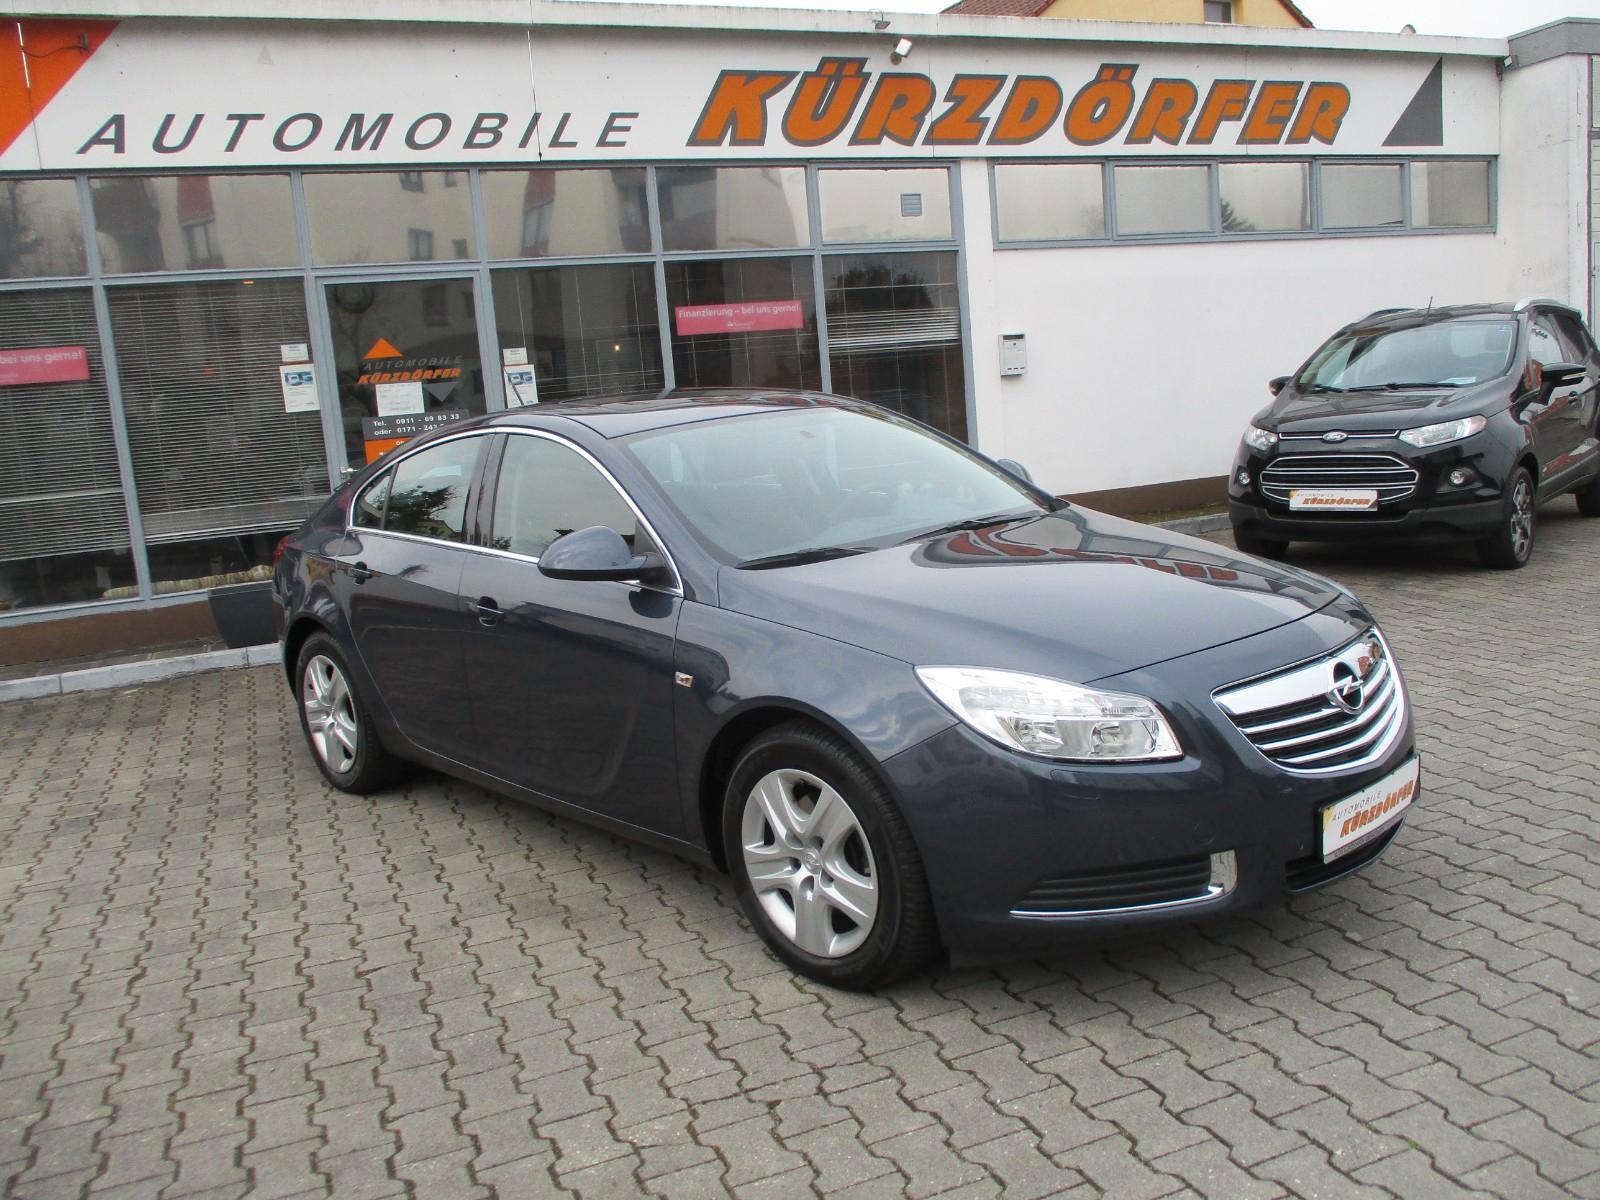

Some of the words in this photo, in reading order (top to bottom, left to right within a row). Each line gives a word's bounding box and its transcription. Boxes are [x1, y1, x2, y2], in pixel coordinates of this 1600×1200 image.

[75, 112, 639, 154] AUTOMOBILE
[685, 56, 1351, 147] KÜRZDÖRFER
[679, 307, 733, 318] Finanzierung
[741, 305, 754, 314] bei
[757, 305, 771, 313] uns
[772, 303, 800, 314] gerne!
[20, 354, 41, 363] uns
[44, 350, 82, 364] gerne!
[364, 355, 463, 370] AUTOMOBILE
[357, 367, 462, 385] KÜRZDÖRFER
[396, 417, 414, 425] 0911
[1332, 790, 1382, 821] AUTOMOBILE
[1340, 780, 1414, 838] KÜRZDÖRFER
